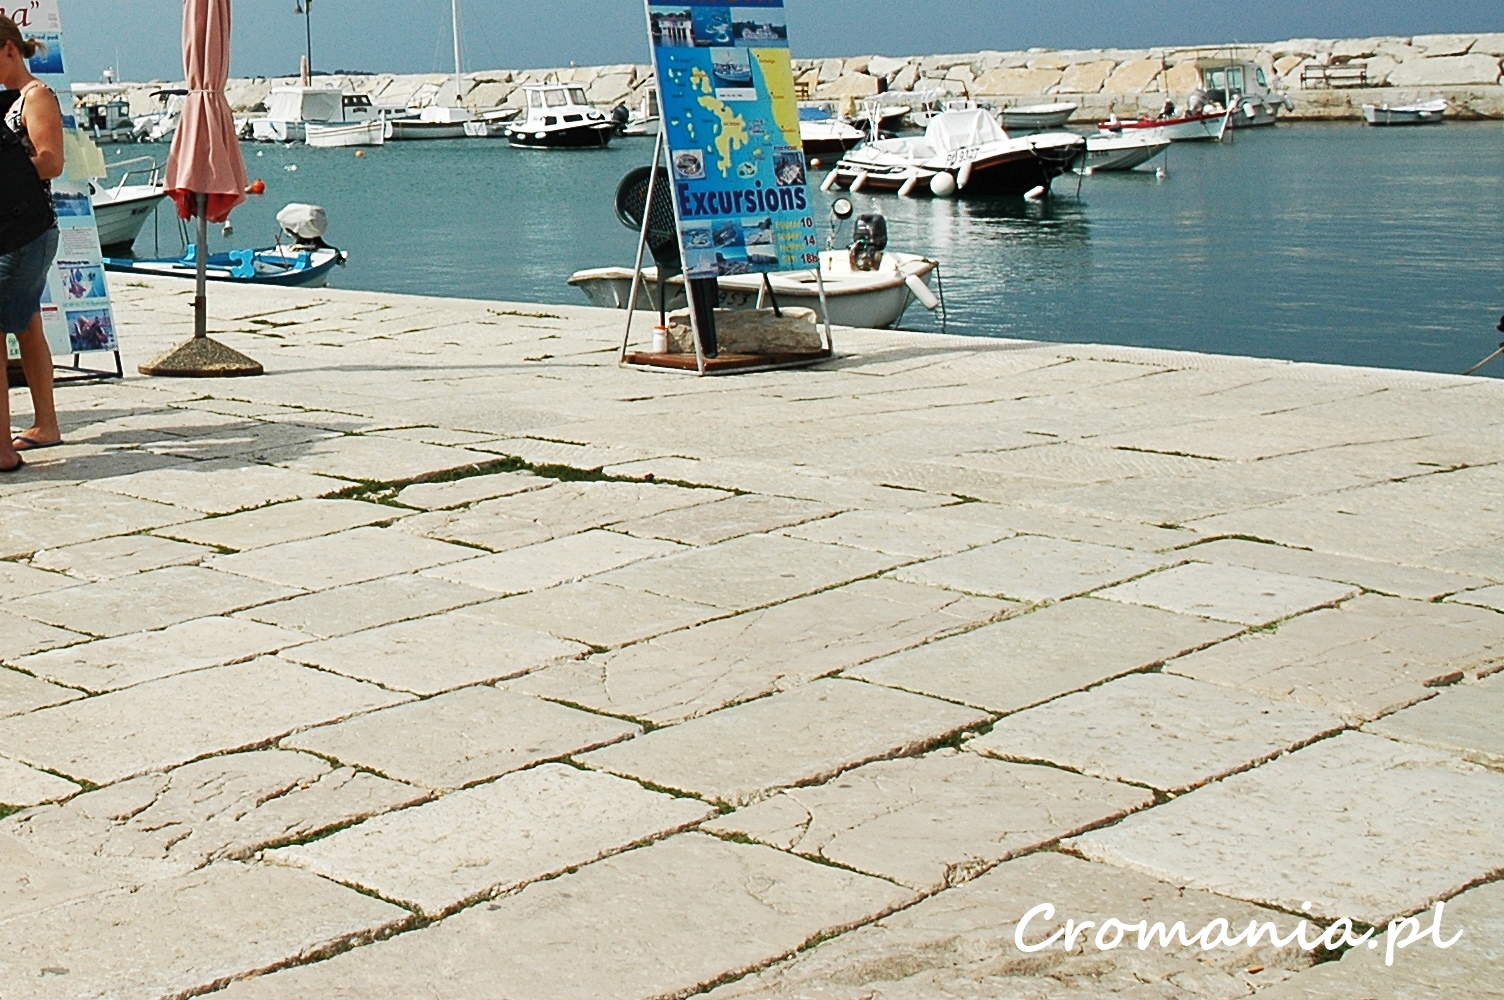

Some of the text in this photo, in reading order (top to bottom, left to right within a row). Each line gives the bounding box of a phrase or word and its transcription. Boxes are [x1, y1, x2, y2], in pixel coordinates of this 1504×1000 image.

[678, 179, 807, 216] Excursions
[800, 216, 813, 229] 10
[803, 234, 816, 246] 14
